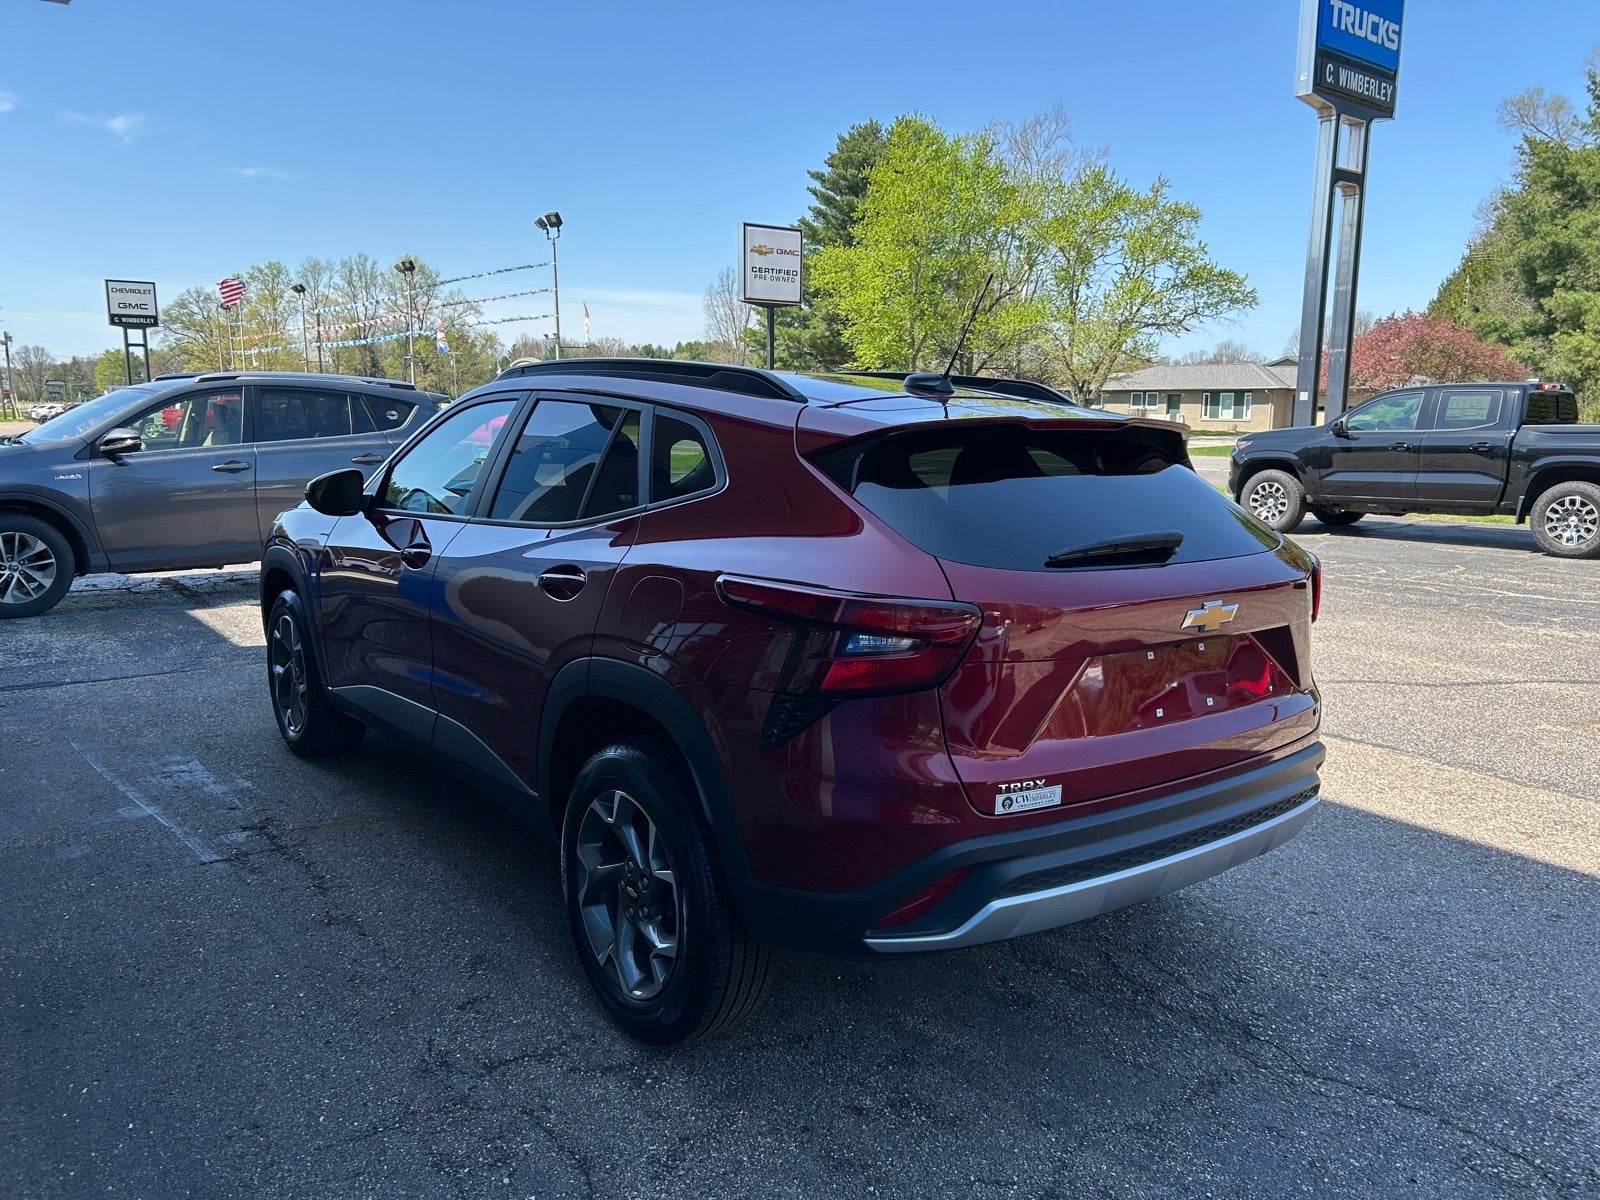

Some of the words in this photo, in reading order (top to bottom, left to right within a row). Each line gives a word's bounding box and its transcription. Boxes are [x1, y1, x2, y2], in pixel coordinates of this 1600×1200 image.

[1329, 0, 1399, 51] TRUCKS
[1326, 63, 1334, 84] C.
[1339, 67, 1393, 102] WIMBERLEY
[776, 248, 800, 257] GMC
[751, 266, 798, 277] CERTIFIED
[753, 274, 796, 283] PRE-OWNED
[111, 287, 152, 295] CHEVROLET
[118, 302, 149, 310] GMC
[998, 779, 1046, 793] TRAX
